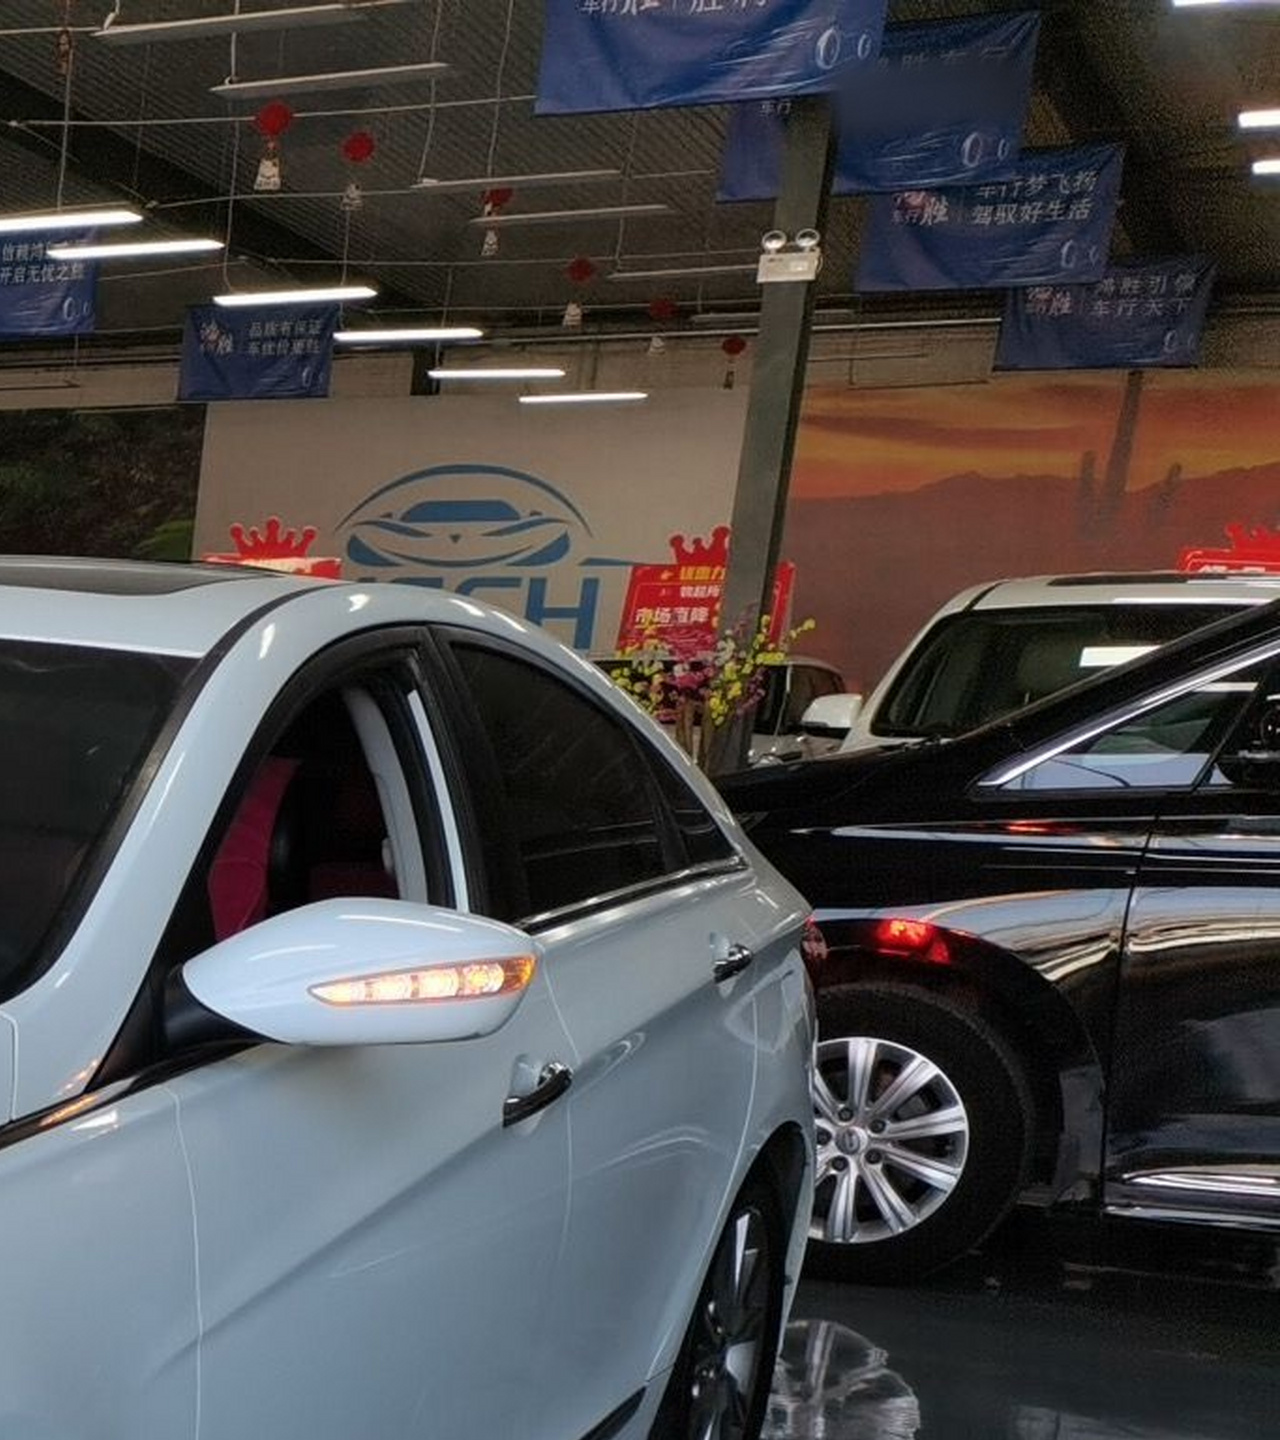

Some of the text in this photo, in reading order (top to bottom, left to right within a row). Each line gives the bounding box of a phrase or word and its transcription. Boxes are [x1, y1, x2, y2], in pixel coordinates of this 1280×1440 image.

[971, 198, 1092, 226] 驾驭好生活
